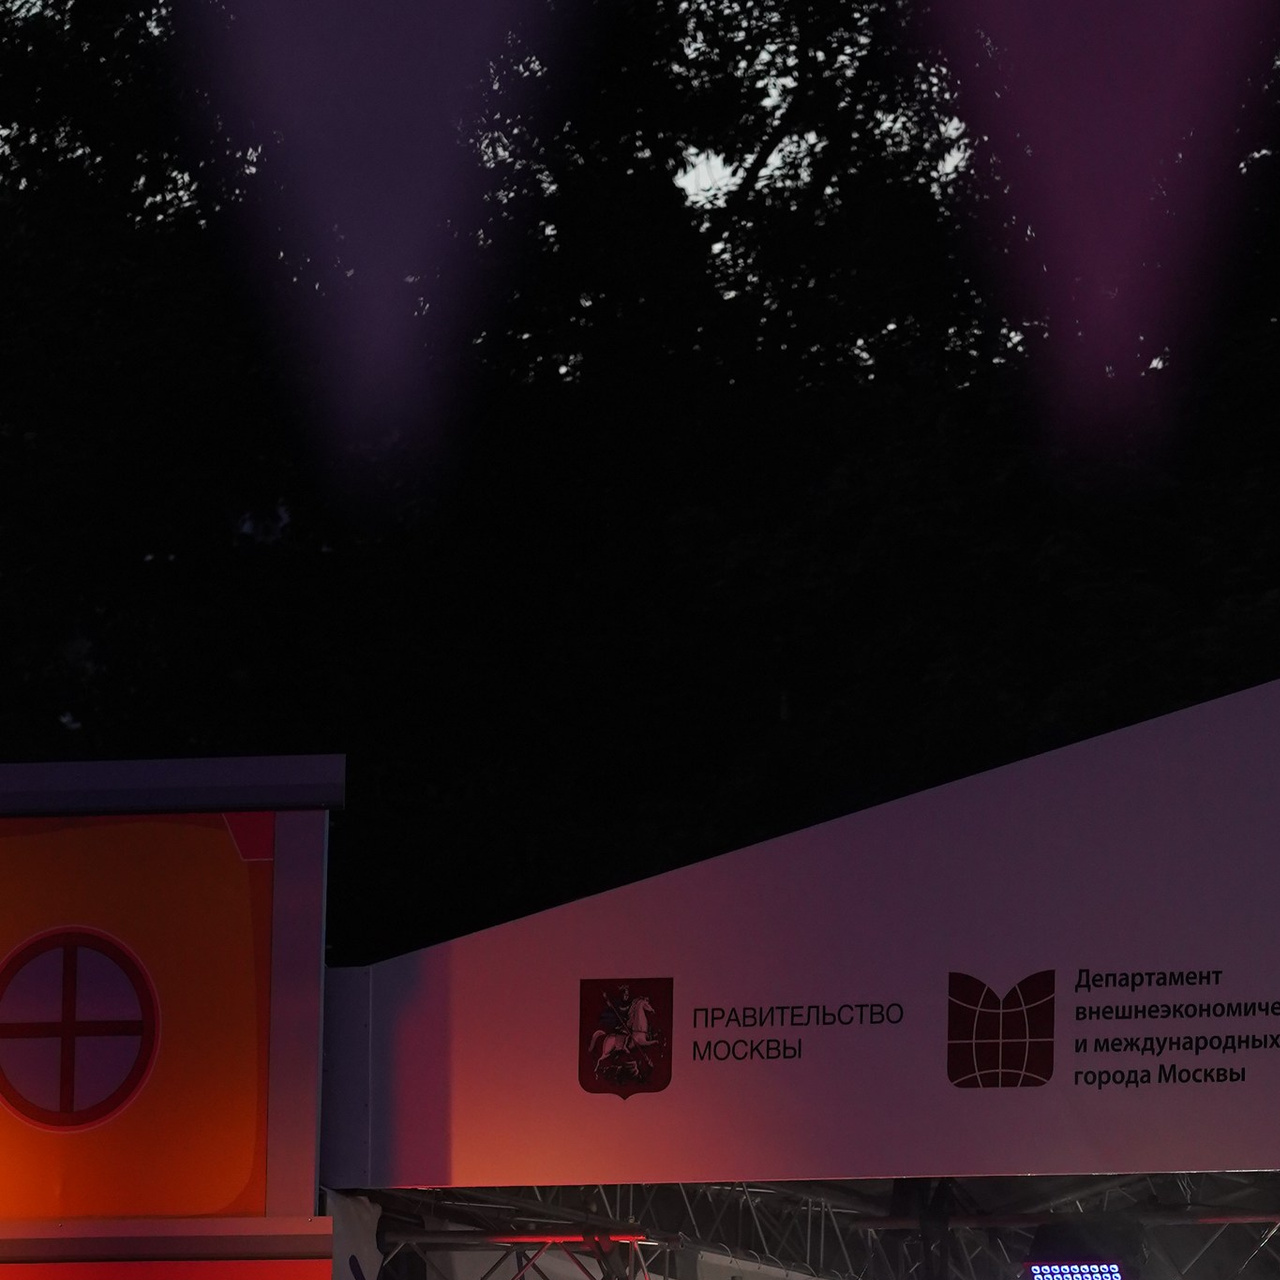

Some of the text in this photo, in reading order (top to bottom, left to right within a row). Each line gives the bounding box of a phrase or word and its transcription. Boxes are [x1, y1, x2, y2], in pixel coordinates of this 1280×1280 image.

[1075, 969, 1223, 992] Департамент
[693, 1003, 904, 1028] ПРАВИТЕЛЬСТВО
[693, 1038, 801, 1061] МОСКВЫ
[1075, 1037, 1087, 1053] и
[1094, 1032, 1280, 1056] международных
[1074, 1064, 1246, 1089] города Москвы
